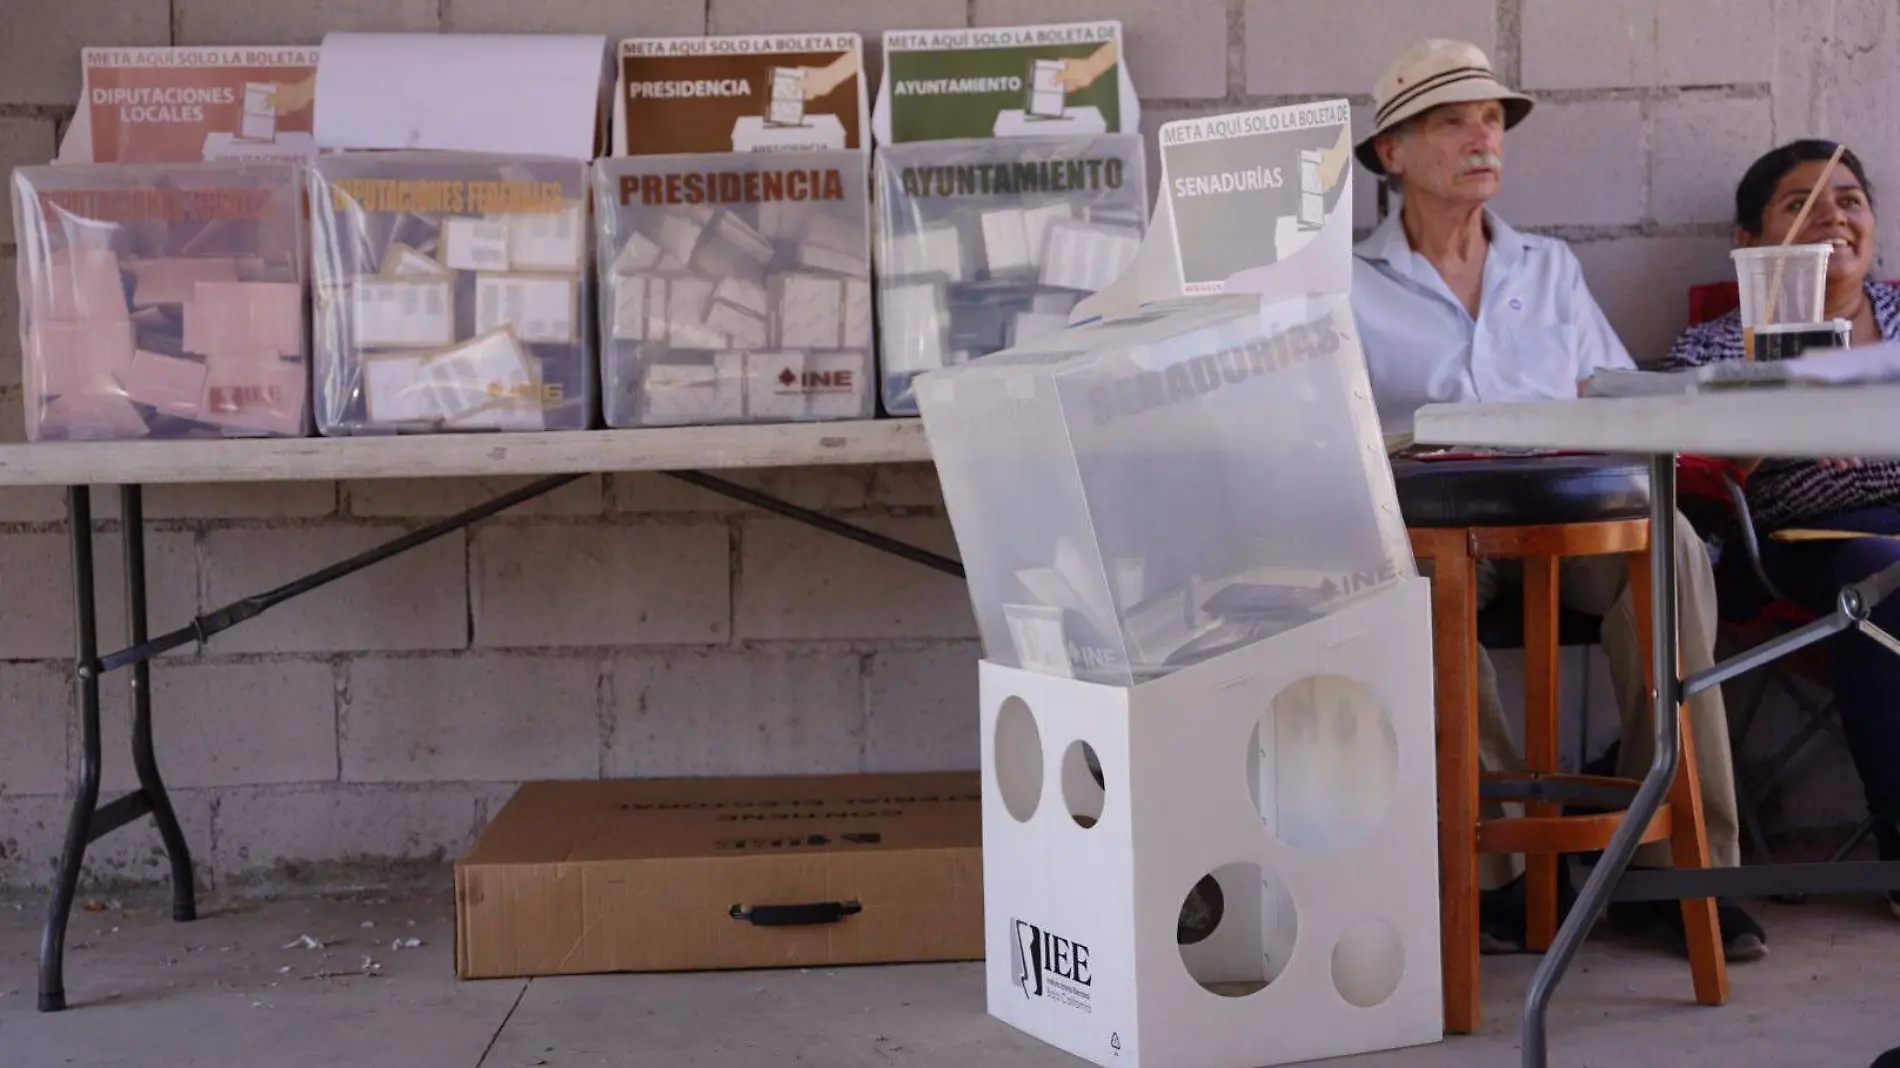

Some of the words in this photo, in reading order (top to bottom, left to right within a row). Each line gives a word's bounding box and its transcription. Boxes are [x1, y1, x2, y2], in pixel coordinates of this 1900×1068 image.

[623, 41, 666, 54] META
[669, 38, 707, 54] AQUÍ
[710, 38, 750, 52] SOLO
[753, 37, 771, 50] LA
[776, 36, 832, 50] BOLETA
[836, 35, 856, 48] DE
[888, 34, 926, 47] META
[931, 30, 968, 46] AQUÍ
[972, 31, 1011, 46] SOLO
[1015, 30, 1033, 43] LA
[1037, 26, 1093, 42] BOLETA
[1097, 25, 1116, 38] DE
[88, 52, 132, 65] META
[178, 52, 218, 65] SOLO
[222, 52, 242, 65] LA
[246, 51, 306, 65] BOLETA
[92, 87, 235, 105] DIPUTACIONES
[629, 79, 752, 98] PRESIDENCIA
[894, 77, 1022, 95] AYUNTAMIENTO
[120, 105, 205, 123] LOCALES
[1163, 125, 1202, 143] META
[1206, 116, 1242, 139] AQUÍ
[1245, 114, 1280, 133] SOLO
[1281, 111, 1297, 127] LA
[1299, 105, 1336, 126] BOLETA
[1336, 104, 1349, 123] DE
[902, 157, 1124, 197] AYUNTAMIENTO
[1175, 165, 1284, 198] SENADURÍAS
[618, 169, 844, 206] PRESIDENCIA
[801, 370, 852, 388] INE
[1343, 559, 1397, 596] INE
[1043, 930, 1092, 987] IEE
